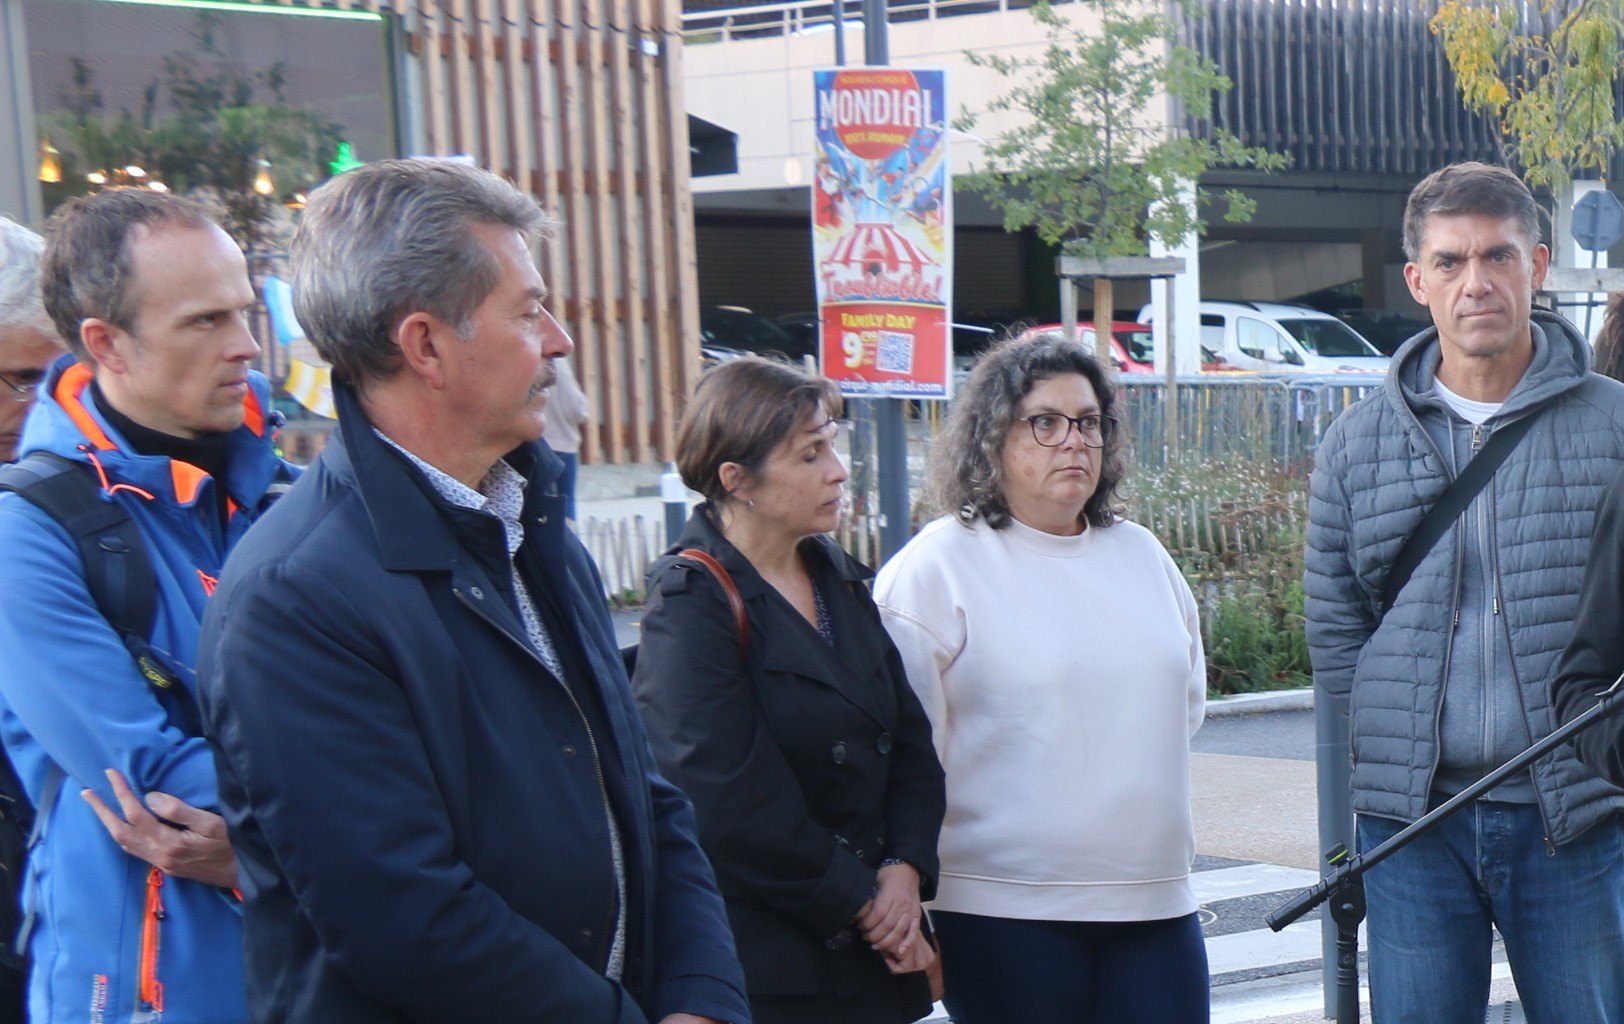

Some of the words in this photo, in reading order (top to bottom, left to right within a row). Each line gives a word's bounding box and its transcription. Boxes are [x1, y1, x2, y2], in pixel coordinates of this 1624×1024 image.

[819, 88, 937, 131] MONDIAL
[841, 313, 884, 328] FAMILY
[885, 314, 917, 330] DAY
[842, 331, 862, 369] 9
